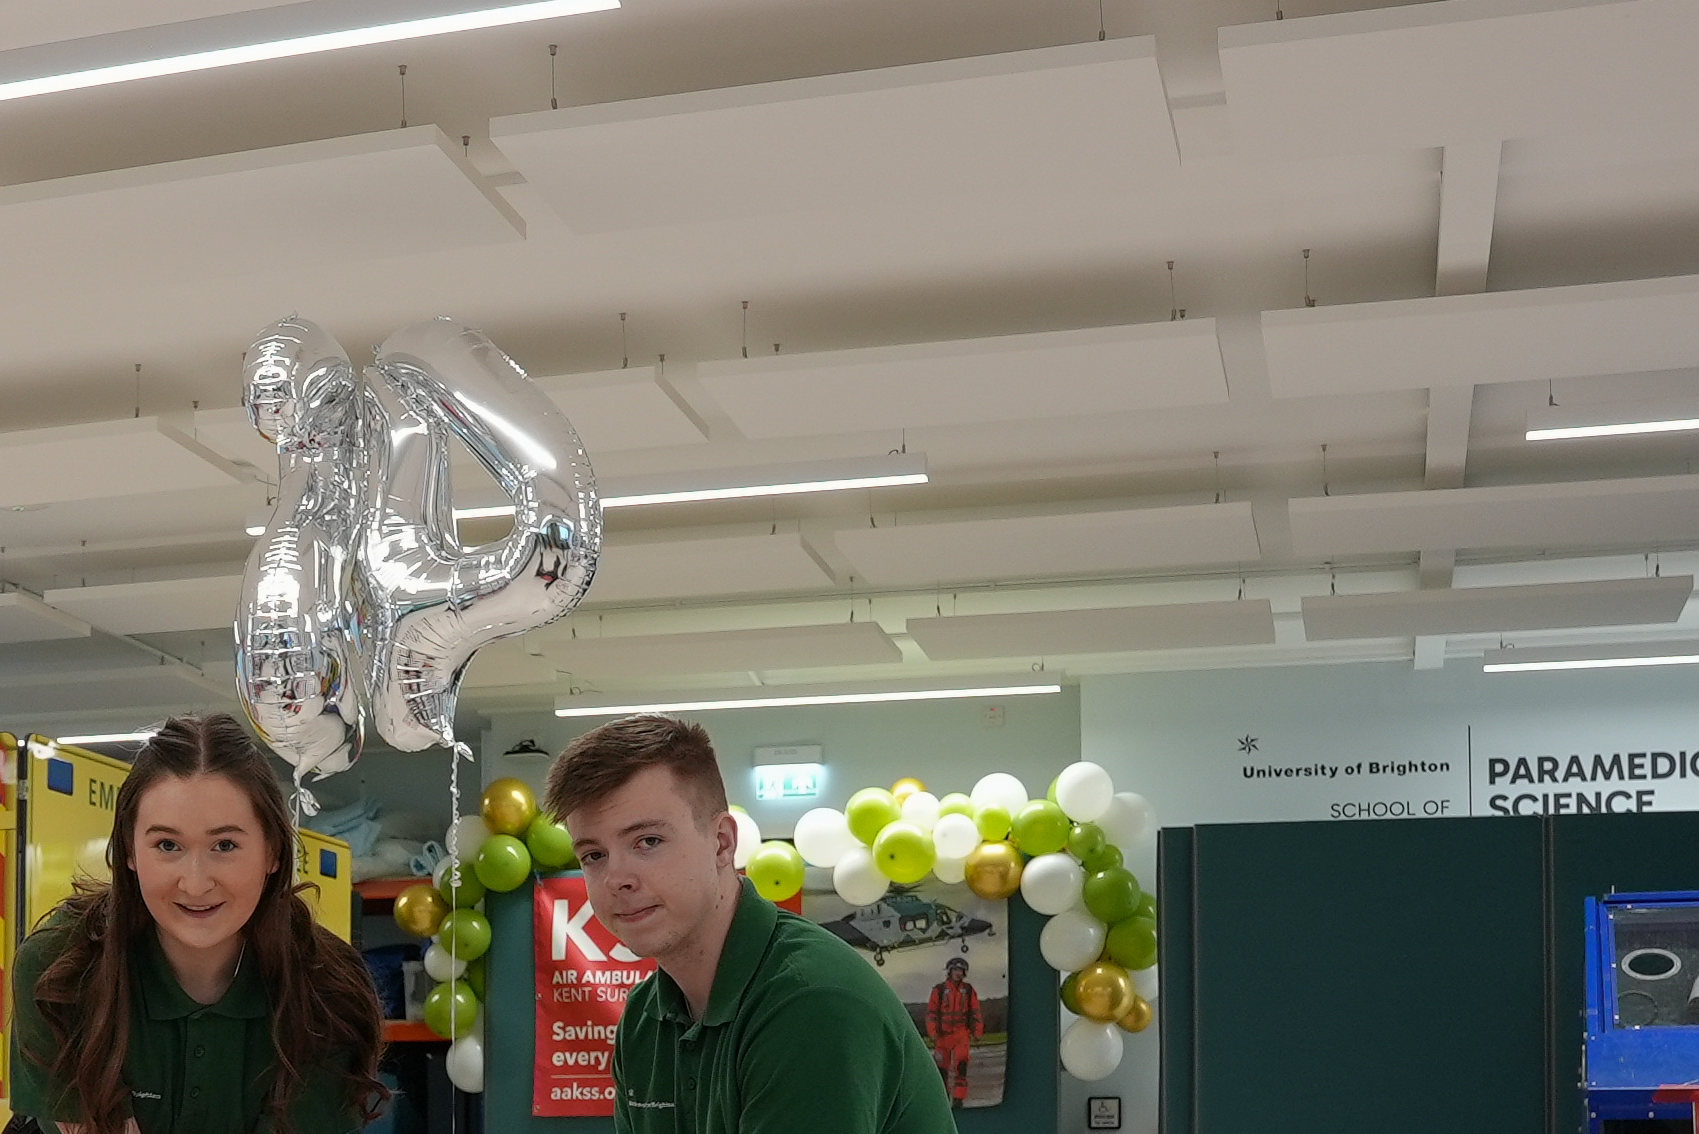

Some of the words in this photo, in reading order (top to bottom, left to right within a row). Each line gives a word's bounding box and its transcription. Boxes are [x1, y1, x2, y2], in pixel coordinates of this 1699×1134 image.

[1242, 763, 1338, 779] University
[1344, 763, 1362, 776] of
[1369, 761, 1451, 777] Brighton
[1330, 801, 1416, 819] SCHOOL
[1423, 800, 1451, 816] OF
[552, 970, 577, 985] AIR
[553, 987, 592, 1003] KENT
[552, 1020, 618, 1045] Saving
[552, 1051, 609, 1071] every
